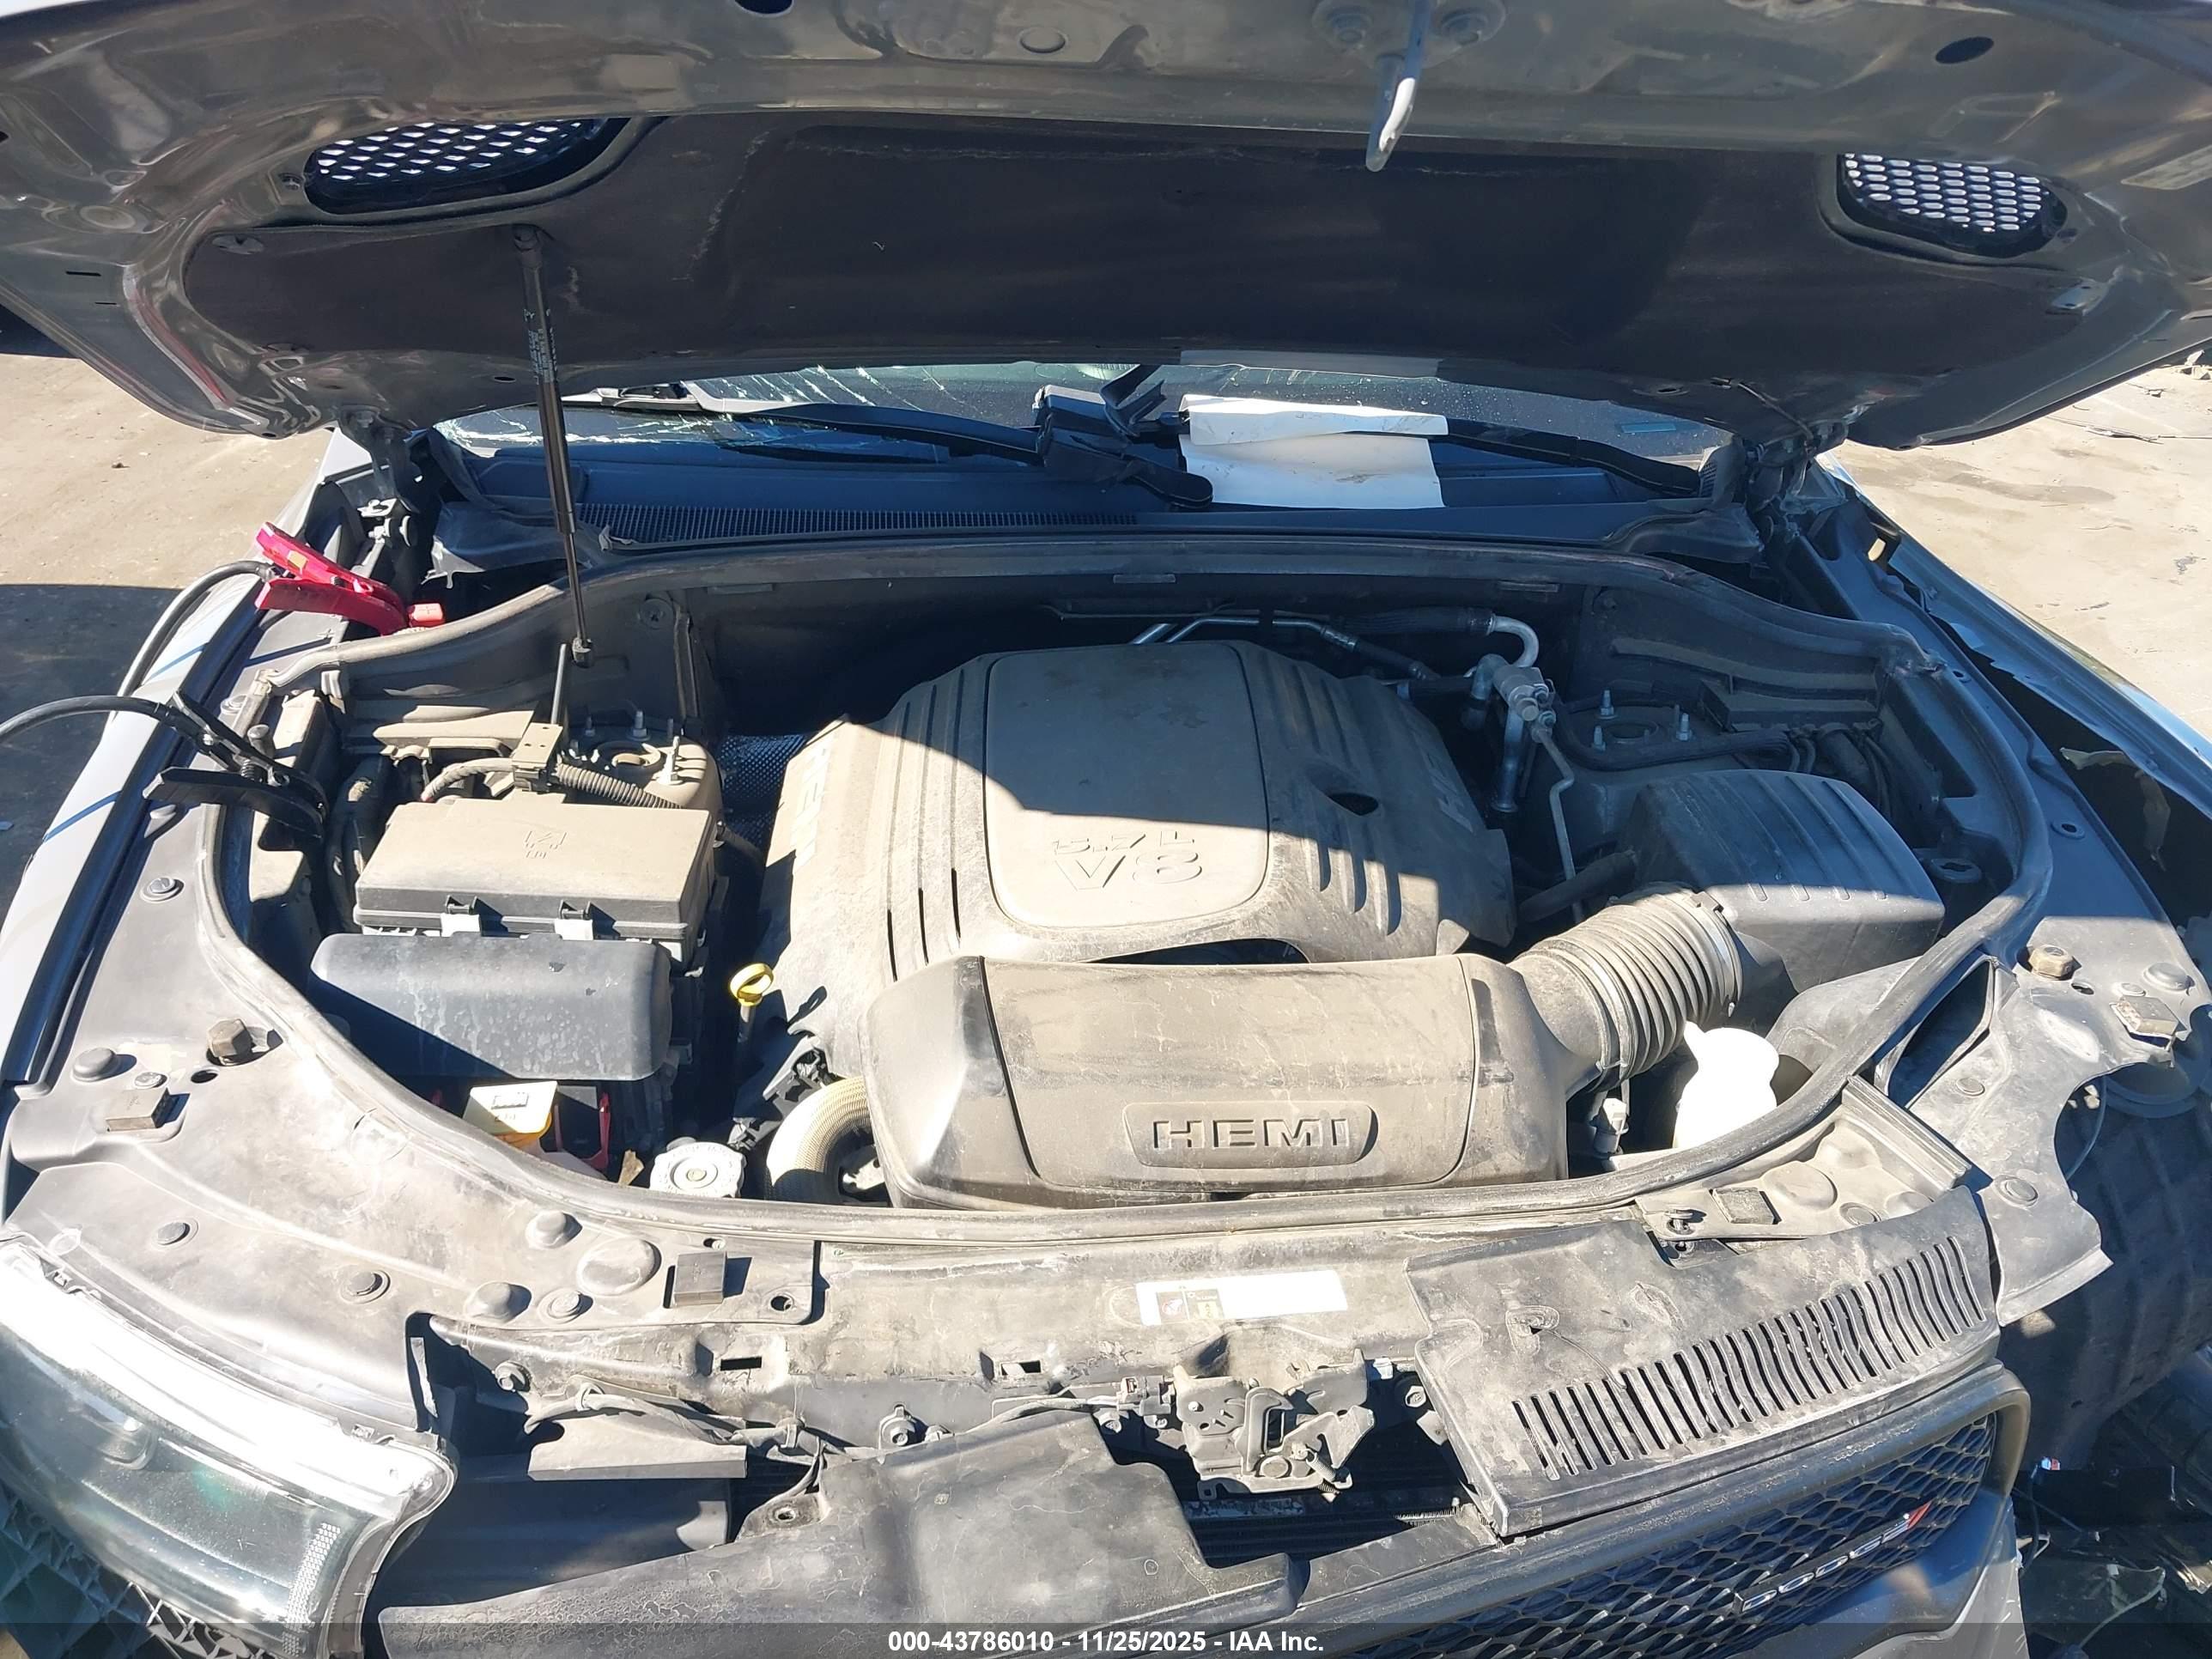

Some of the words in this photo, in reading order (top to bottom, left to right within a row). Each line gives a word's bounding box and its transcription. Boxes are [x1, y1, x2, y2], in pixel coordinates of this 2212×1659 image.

[1054, 848, 1203, 891] V8
[1152, 1118, 1351, 1149] HEMI
[1741, 1520, 1909, 1612] DODGE
